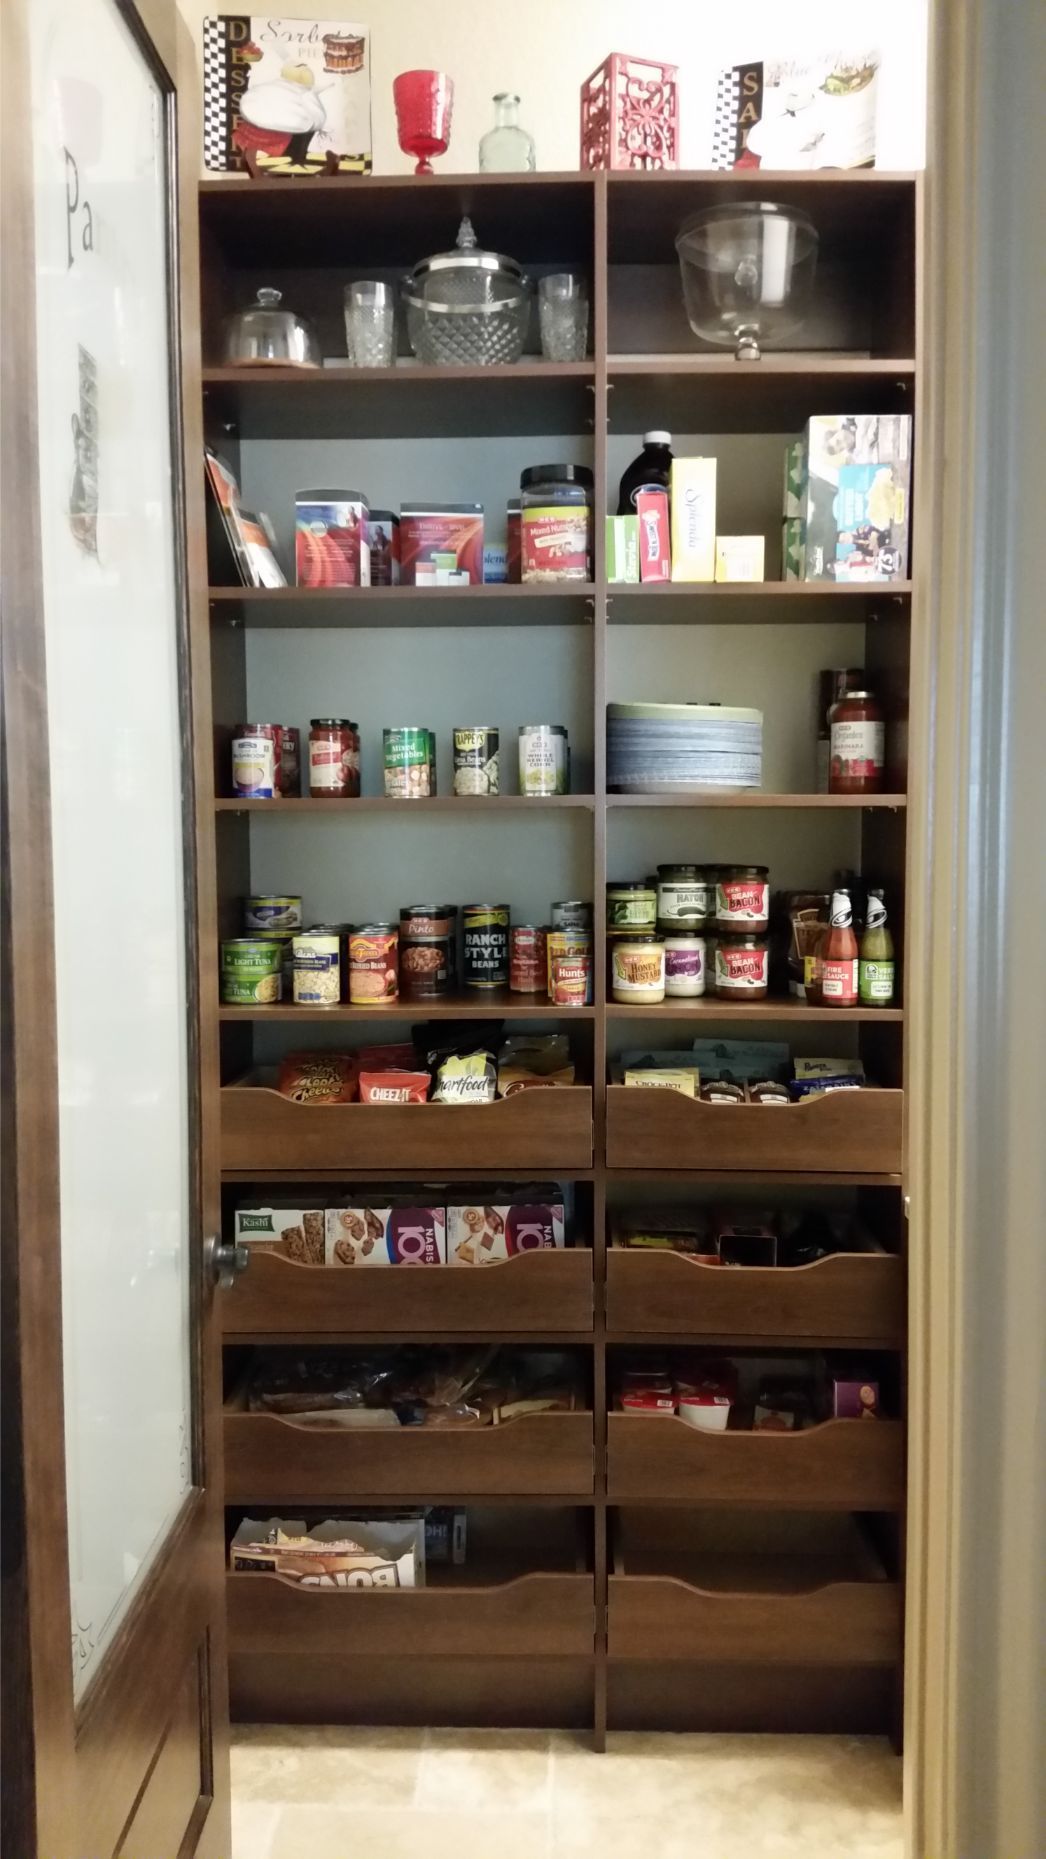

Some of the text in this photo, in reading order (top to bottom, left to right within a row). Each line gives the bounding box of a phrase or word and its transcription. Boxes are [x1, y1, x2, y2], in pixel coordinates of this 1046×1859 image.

[684, 488, 701, 548] Splenda
[391, 743, 416, 752] Mixed
[731, 890, 753, 899] BEAN
[729, 894, 760, 909] BACON
[408, 923, 434, 935] Pinto
[465, 934, 506, 946] RANCH
[464, 947, 508, 958] STYLE
[234, 958, 272, 966] LIGHT TUNA
[471, 960, 499, 969] BEANS
[731, 958, 755, 967] BEAN
[630, 962, 657, 974] HONEY
[729, 961, 761, 976] BACON
[827, 966, 842, 974] FIRE
[232, 988, 251, 996] TUNA
[242, 1217, 269, 1227] Kashi
[425, 1228, 434, 1264] NABIS
